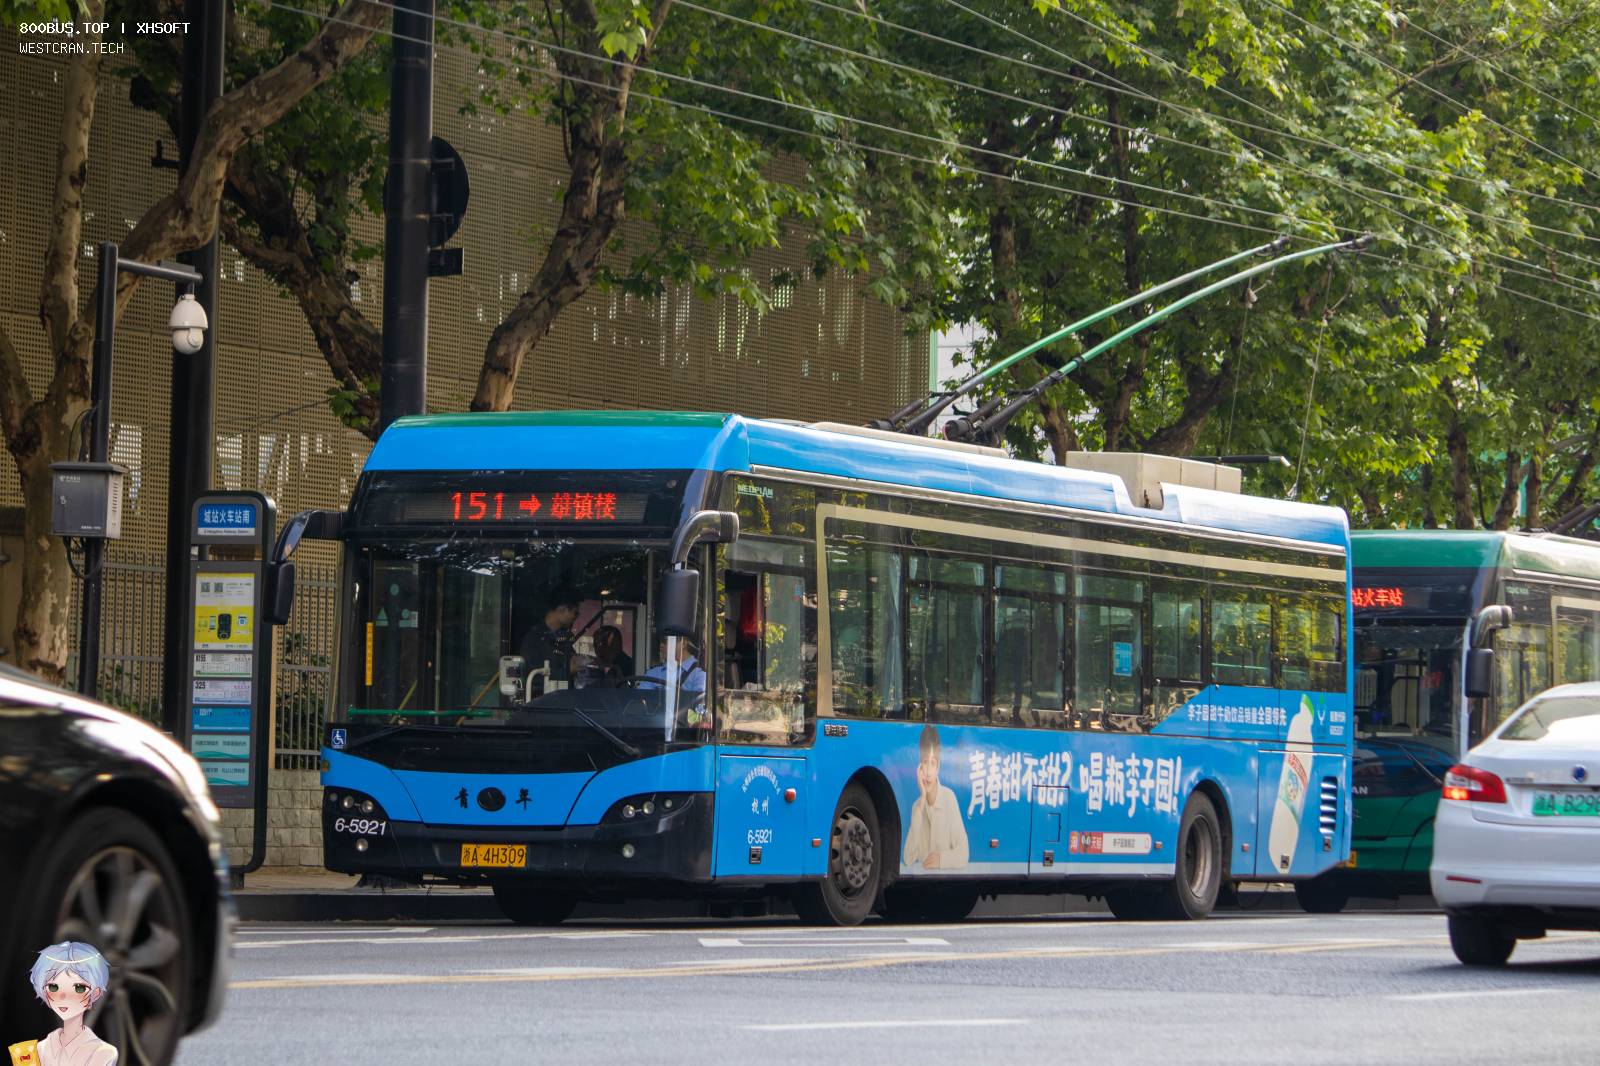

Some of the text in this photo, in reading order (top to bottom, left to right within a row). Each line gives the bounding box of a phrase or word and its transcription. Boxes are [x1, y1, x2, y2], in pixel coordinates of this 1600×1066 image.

[451, 492, 505, 520] 151
[334, 817, 387, 836] 6-5921
[747, 828, 772, 844] 6-5921
